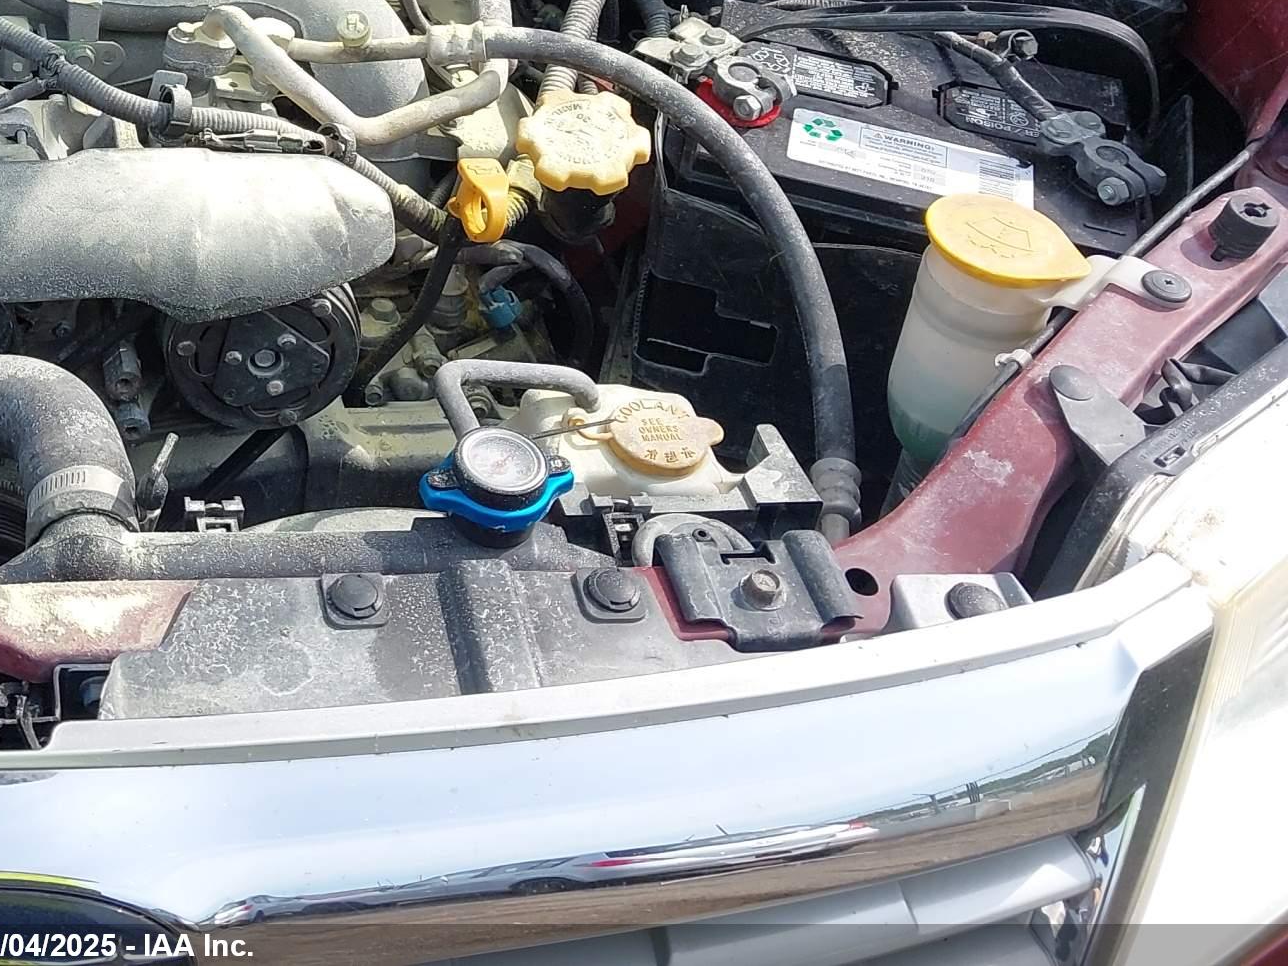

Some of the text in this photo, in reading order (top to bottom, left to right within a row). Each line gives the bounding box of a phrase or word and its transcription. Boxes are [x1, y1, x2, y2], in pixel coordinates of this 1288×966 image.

[614, 400, 690, 424] COOLANT
[641, 418, 664, 427] SEE
[641, 433, 684, 442] MANUAL
